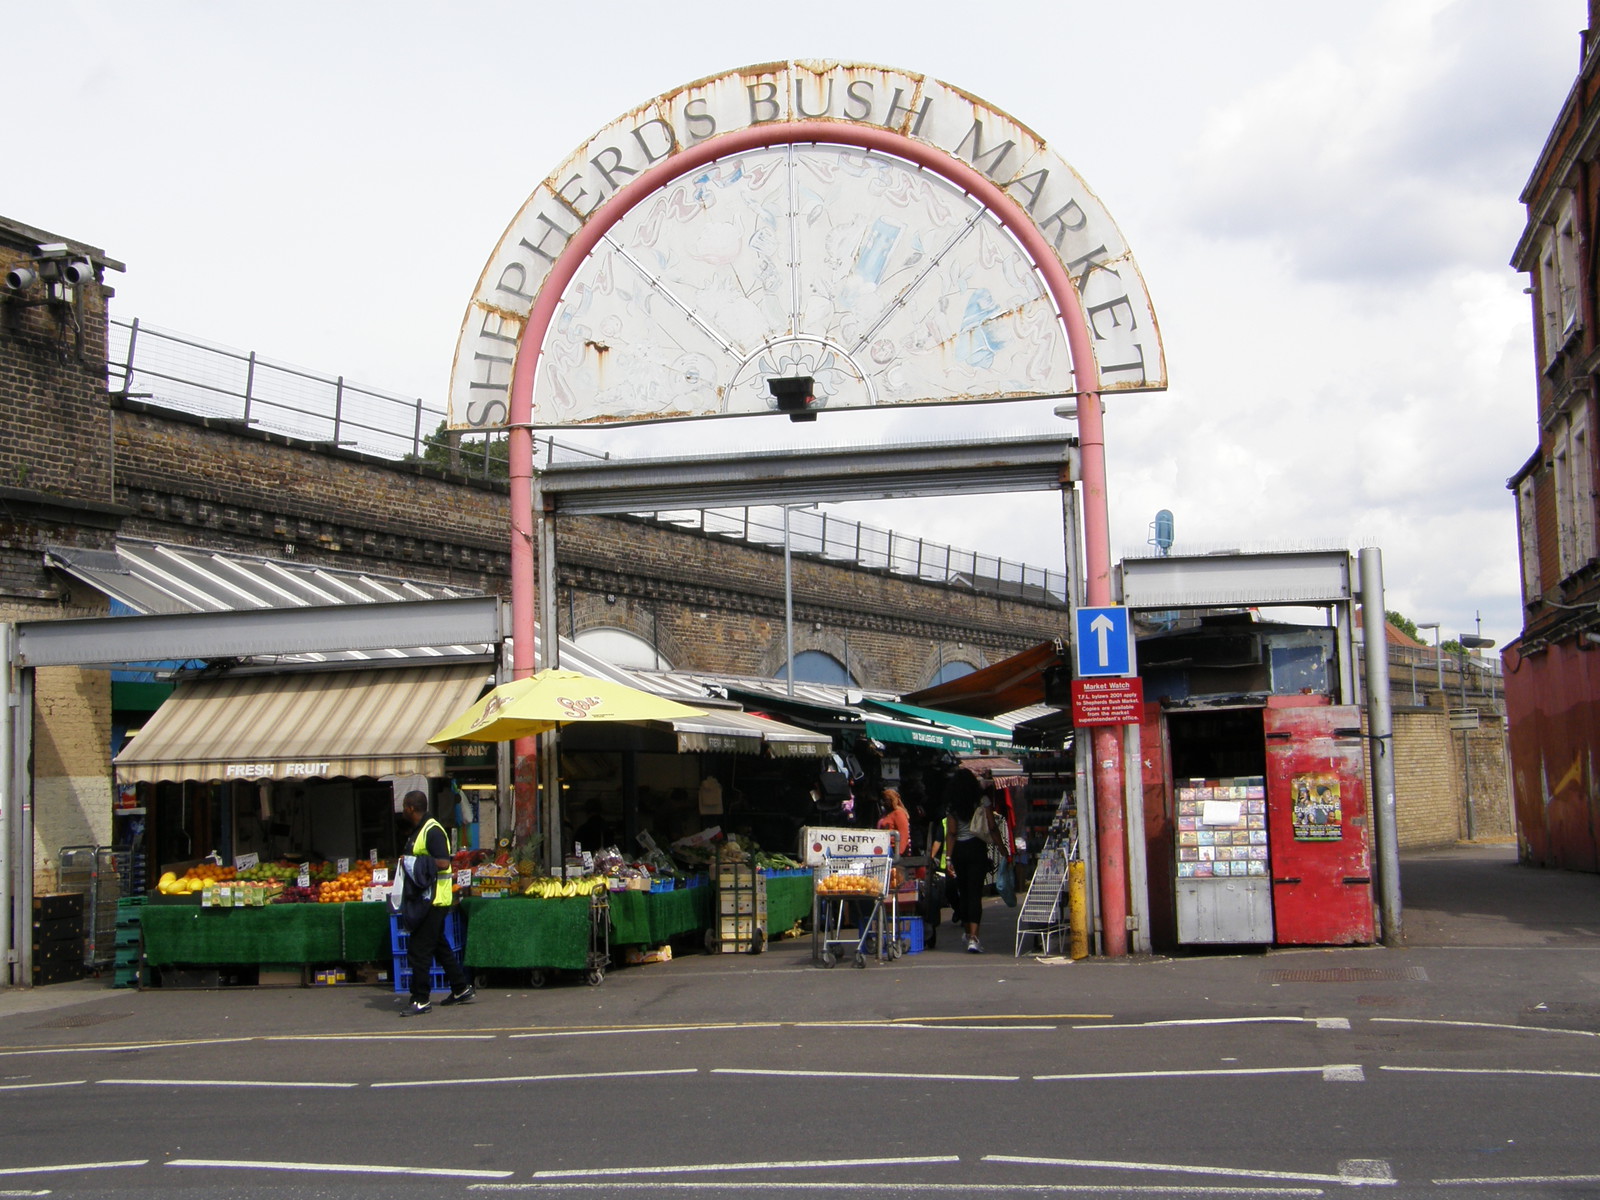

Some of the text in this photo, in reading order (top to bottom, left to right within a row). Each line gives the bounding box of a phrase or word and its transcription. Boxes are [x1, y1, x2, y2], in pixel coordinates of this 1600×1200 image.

[467, 77, 1151, 430] SHEPHERDS BUSH MARKET
[226, 762, 330, 777] FRESH FRUIT
[821, 834, 875, 844] NO ENTRY
[837, 844, 859, 853] FOR
